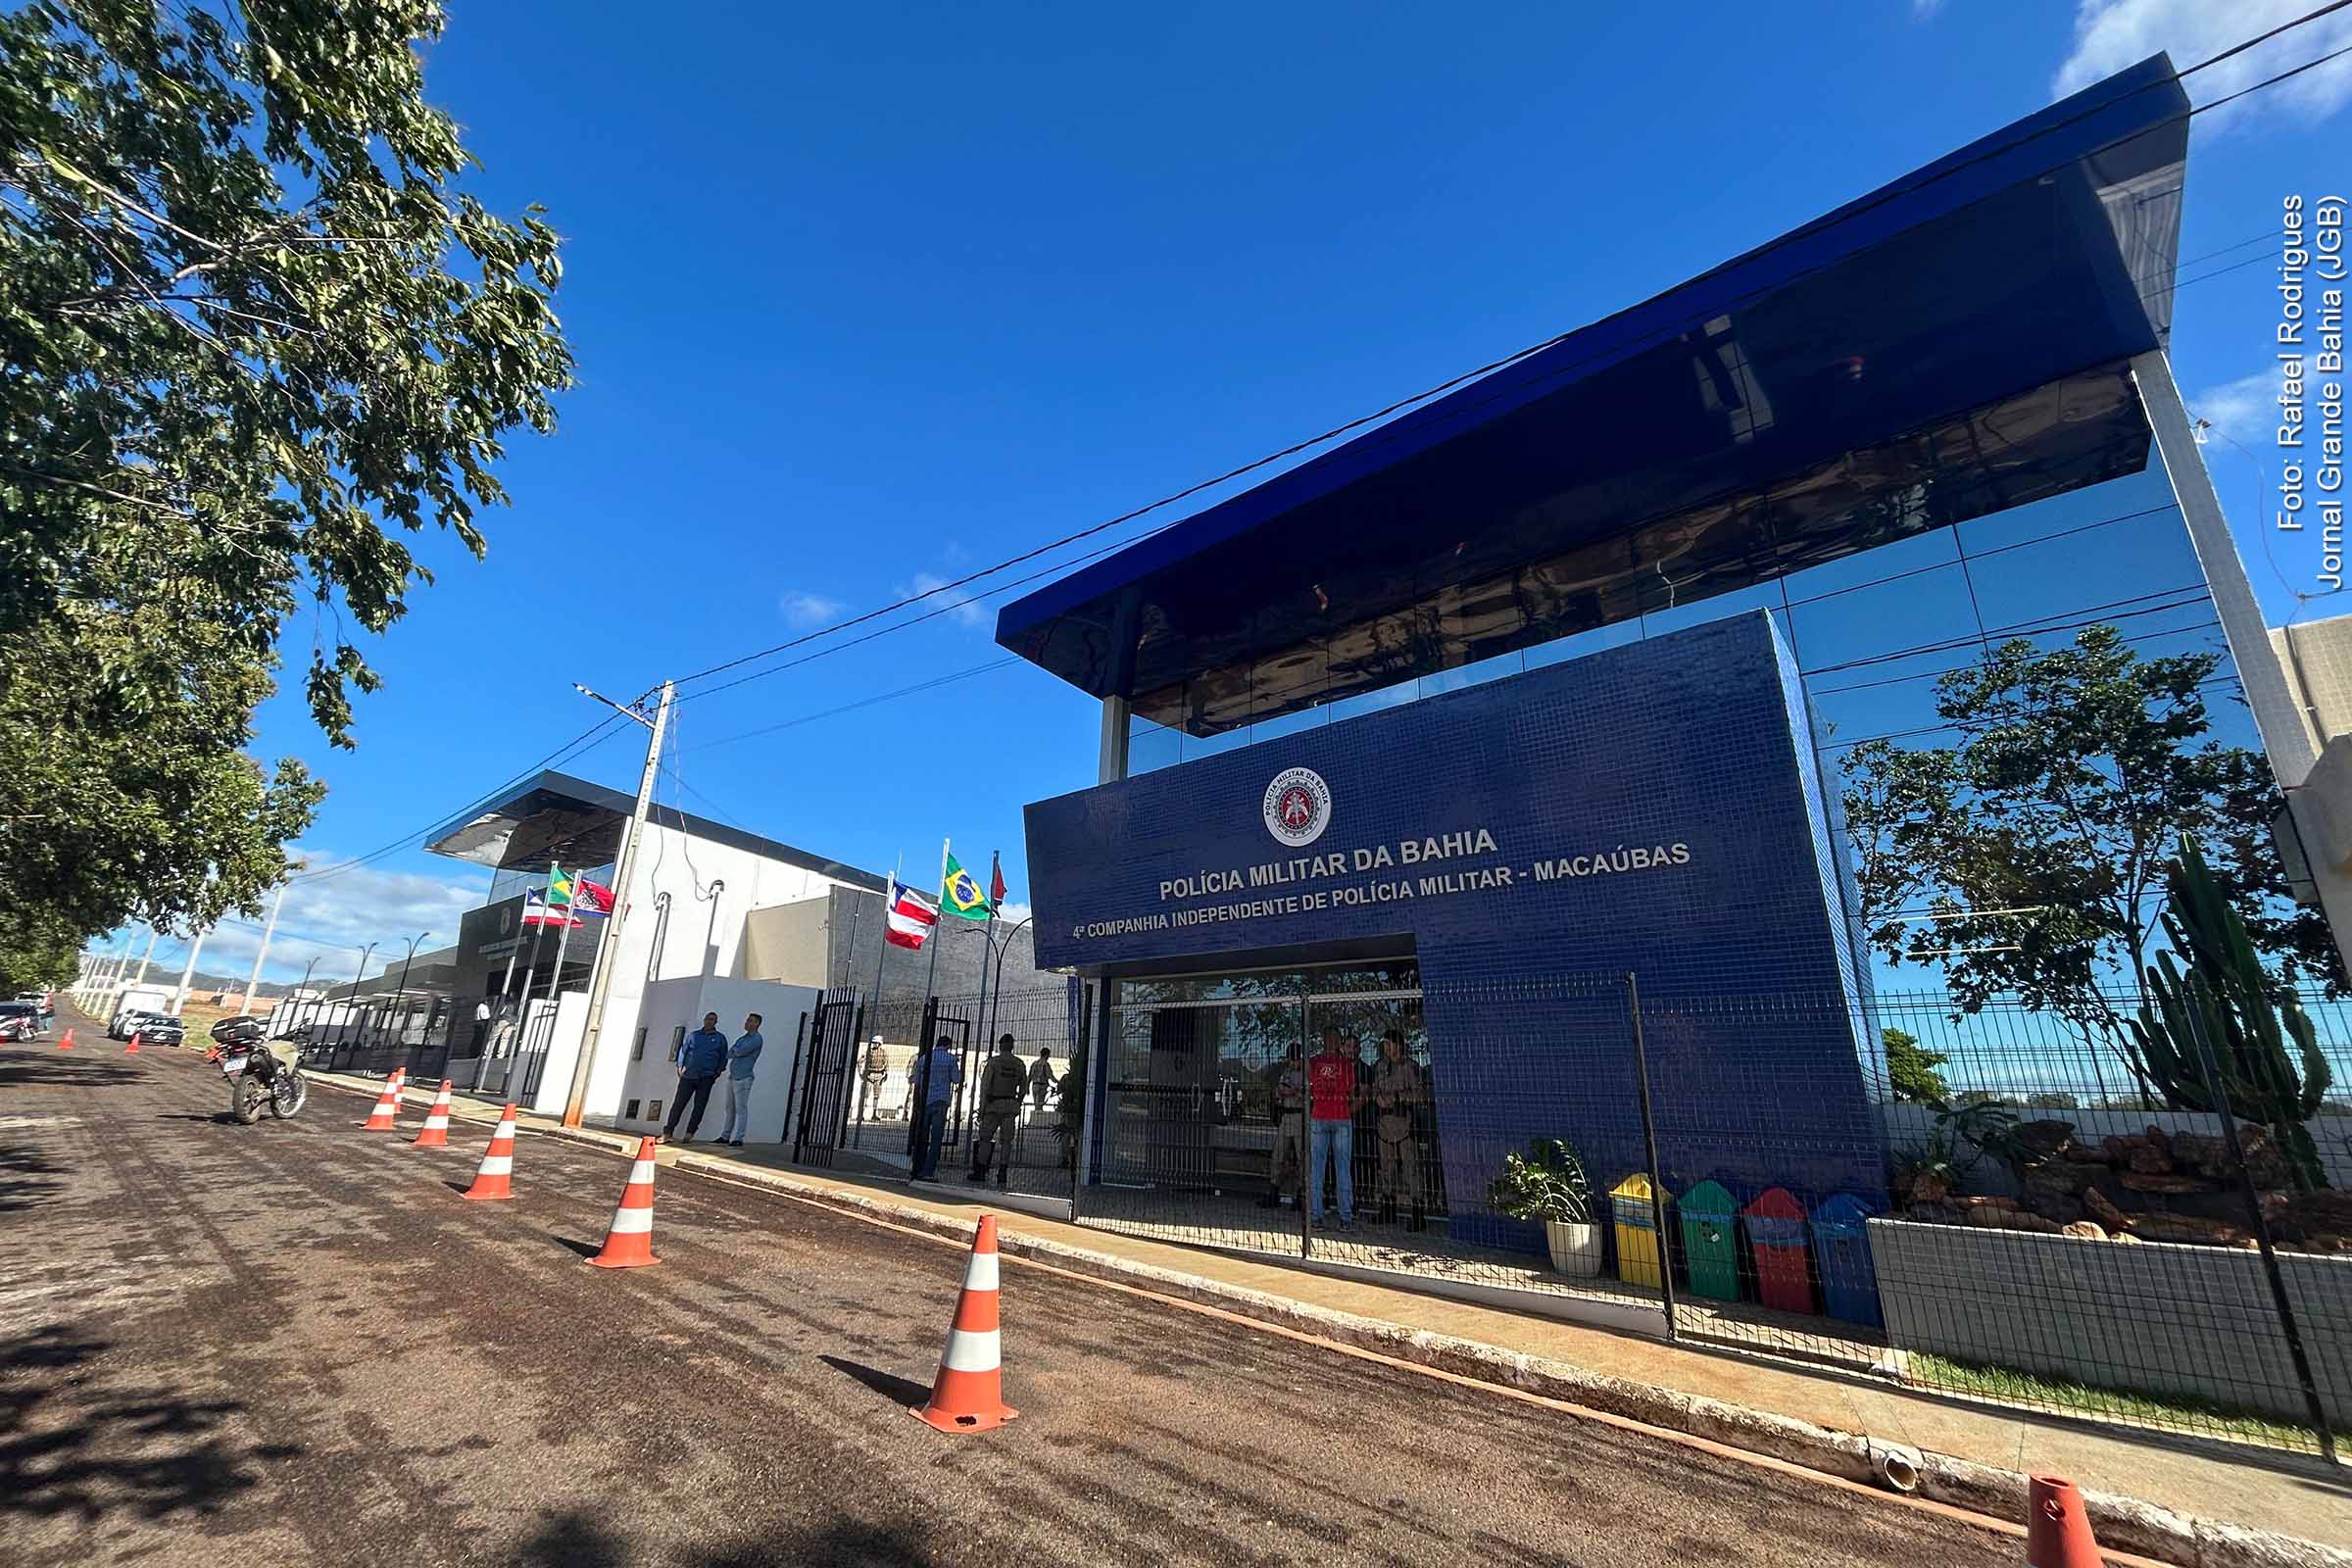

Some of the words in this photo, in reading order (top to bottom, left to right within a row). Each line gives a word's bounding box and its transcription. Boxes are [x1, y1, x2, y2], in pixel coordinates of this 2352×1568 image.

[1277, 770, 1304, 785] MILITAR
[1305, 771, 1315, 782] DA
[1315, 780, 1329, 805] BAHIA
[1087, 913, 1169, 938] COMPANHIA
[1171, 896, 1298, 928] INDEPENDENTE
[1301, 892, 1328, 911] DE
[1331, 879, 1414, 907] POLÍCIA
[1418, 865, 1513, 897] MILITAR
[1533, 842, 1691, 882] MACAÚBAS
[1159, 869, 1245, 901] POLÍCIA
[1249, 852, 1348, 887] MILITAR
[1353, 845, 1395, 871] DA
[1399, 828, 1498, 864] BAHIA
